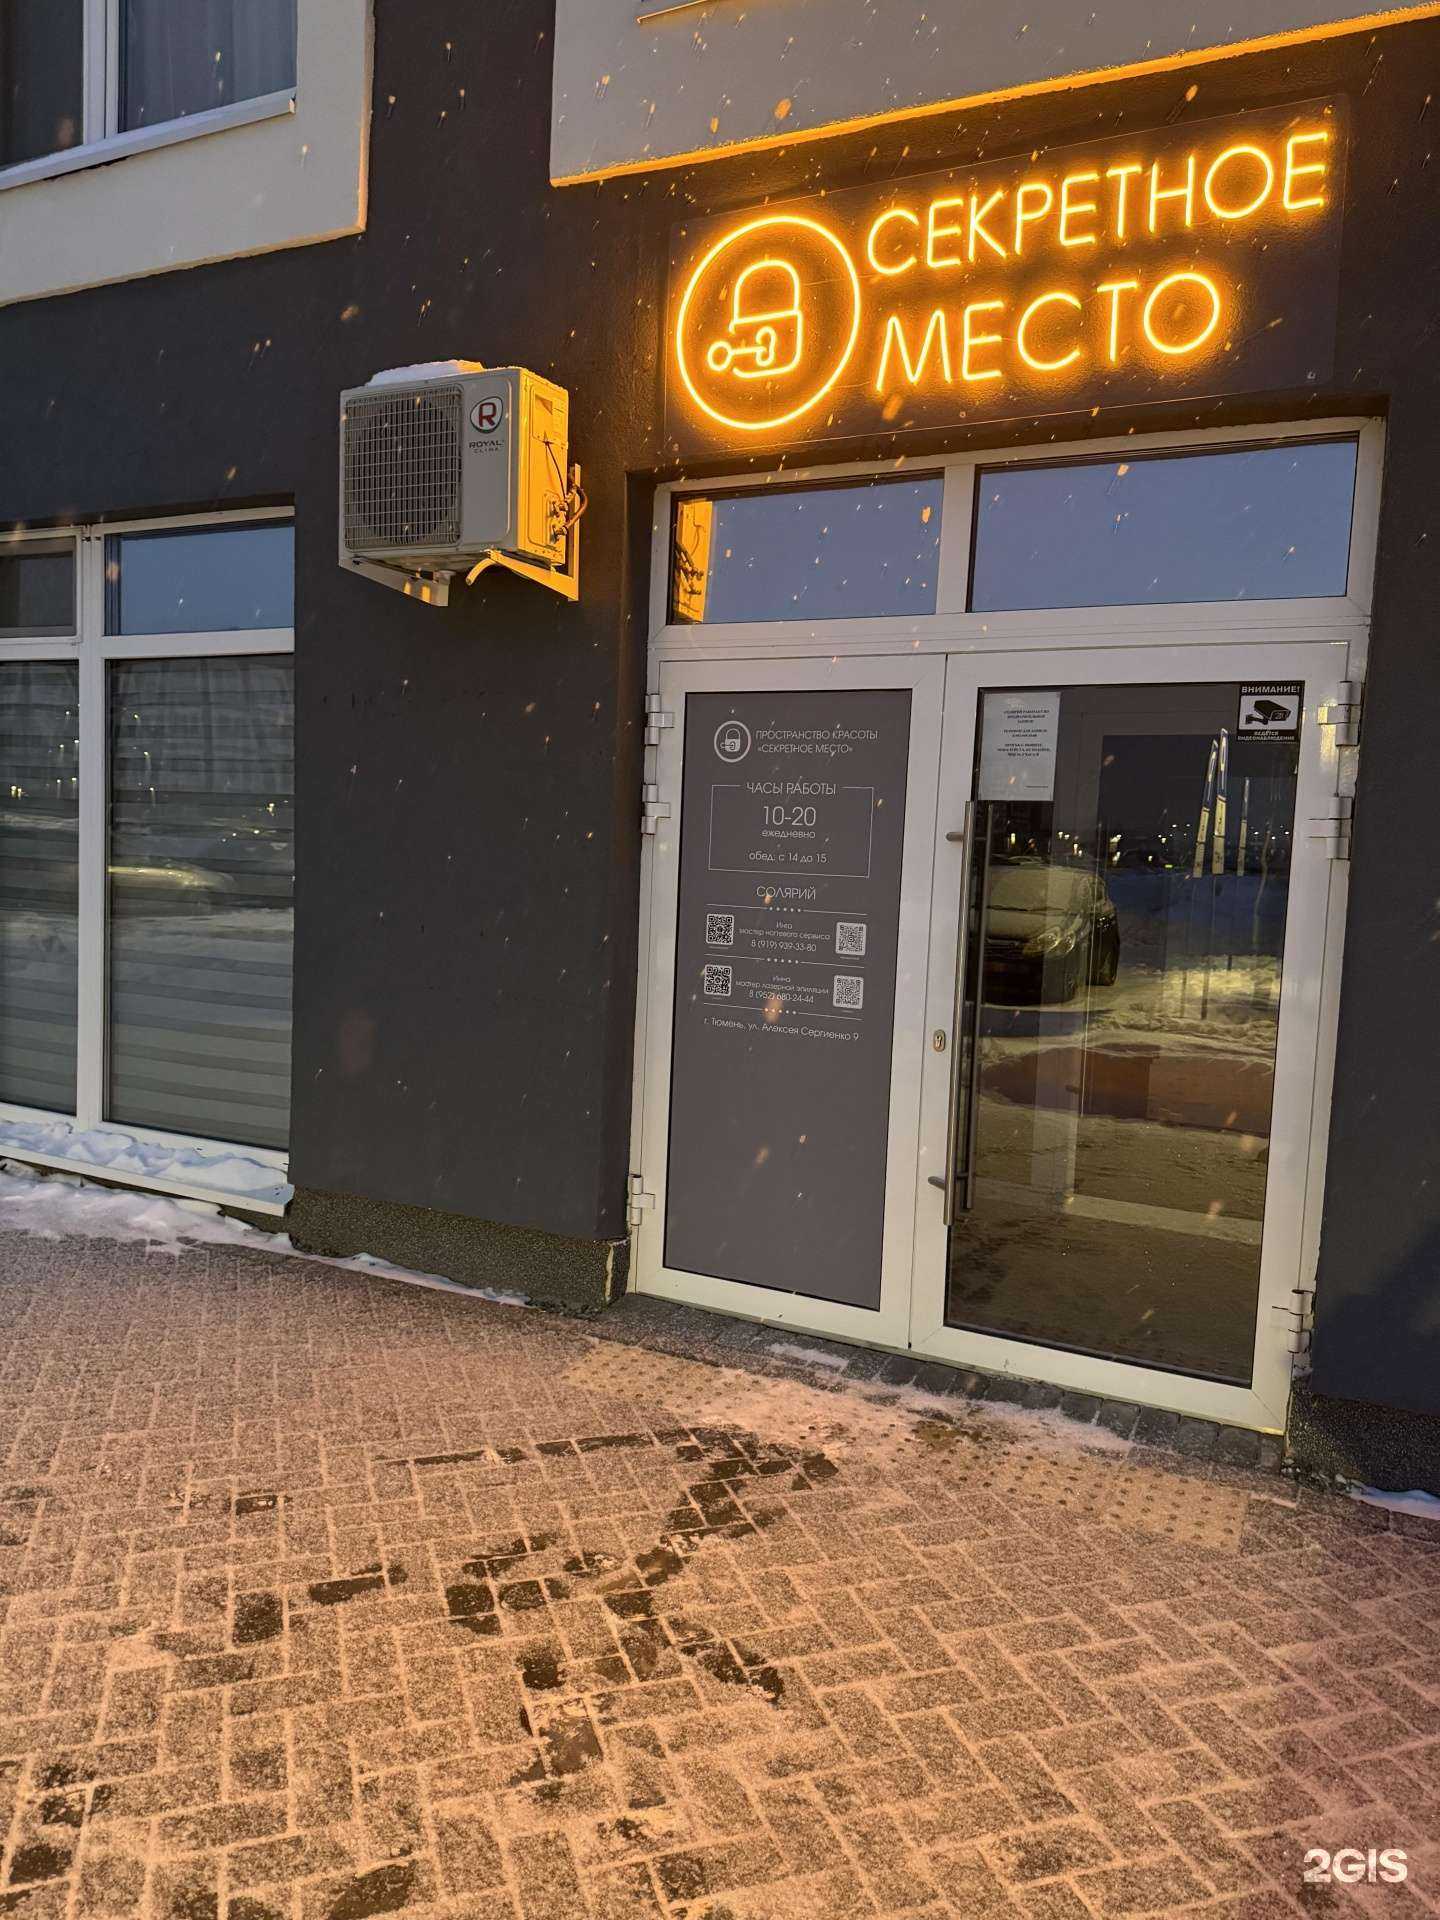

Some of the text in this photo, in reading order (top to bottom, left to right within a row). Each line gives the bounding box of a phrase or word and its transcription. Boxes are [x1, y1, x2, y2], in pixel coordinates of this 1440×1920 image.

[866, 131, 1329, 276] СЕКРЕТНОЕ
[874, 272, 1221, 392] МЕСТО
[469, 440, 503, 449] ROYAL
[1241, 685, 1300, 694] ВНИМАНИЕ!
[755, 730, 879, 741] ПРОСТРАНСТВО КРАСОТЫ
[746, 782, 837, 796] ЧАСЫ РАБОТЫ
[763, 805, 817, 826] 10-20
[761, 830, 816, 839] ежедневно
[788, 853, 798, 863] 14
[800, 855, 813, 864] до
[816, 853, 828, 864] 15
[756, 886, 817, 900] СОЛЯРИЙ
[761, 1023, 799, 1035] Алексея
[800, 1026, 851, 1041] Сергиенко
[853, 1032, 859, 1041] 9
